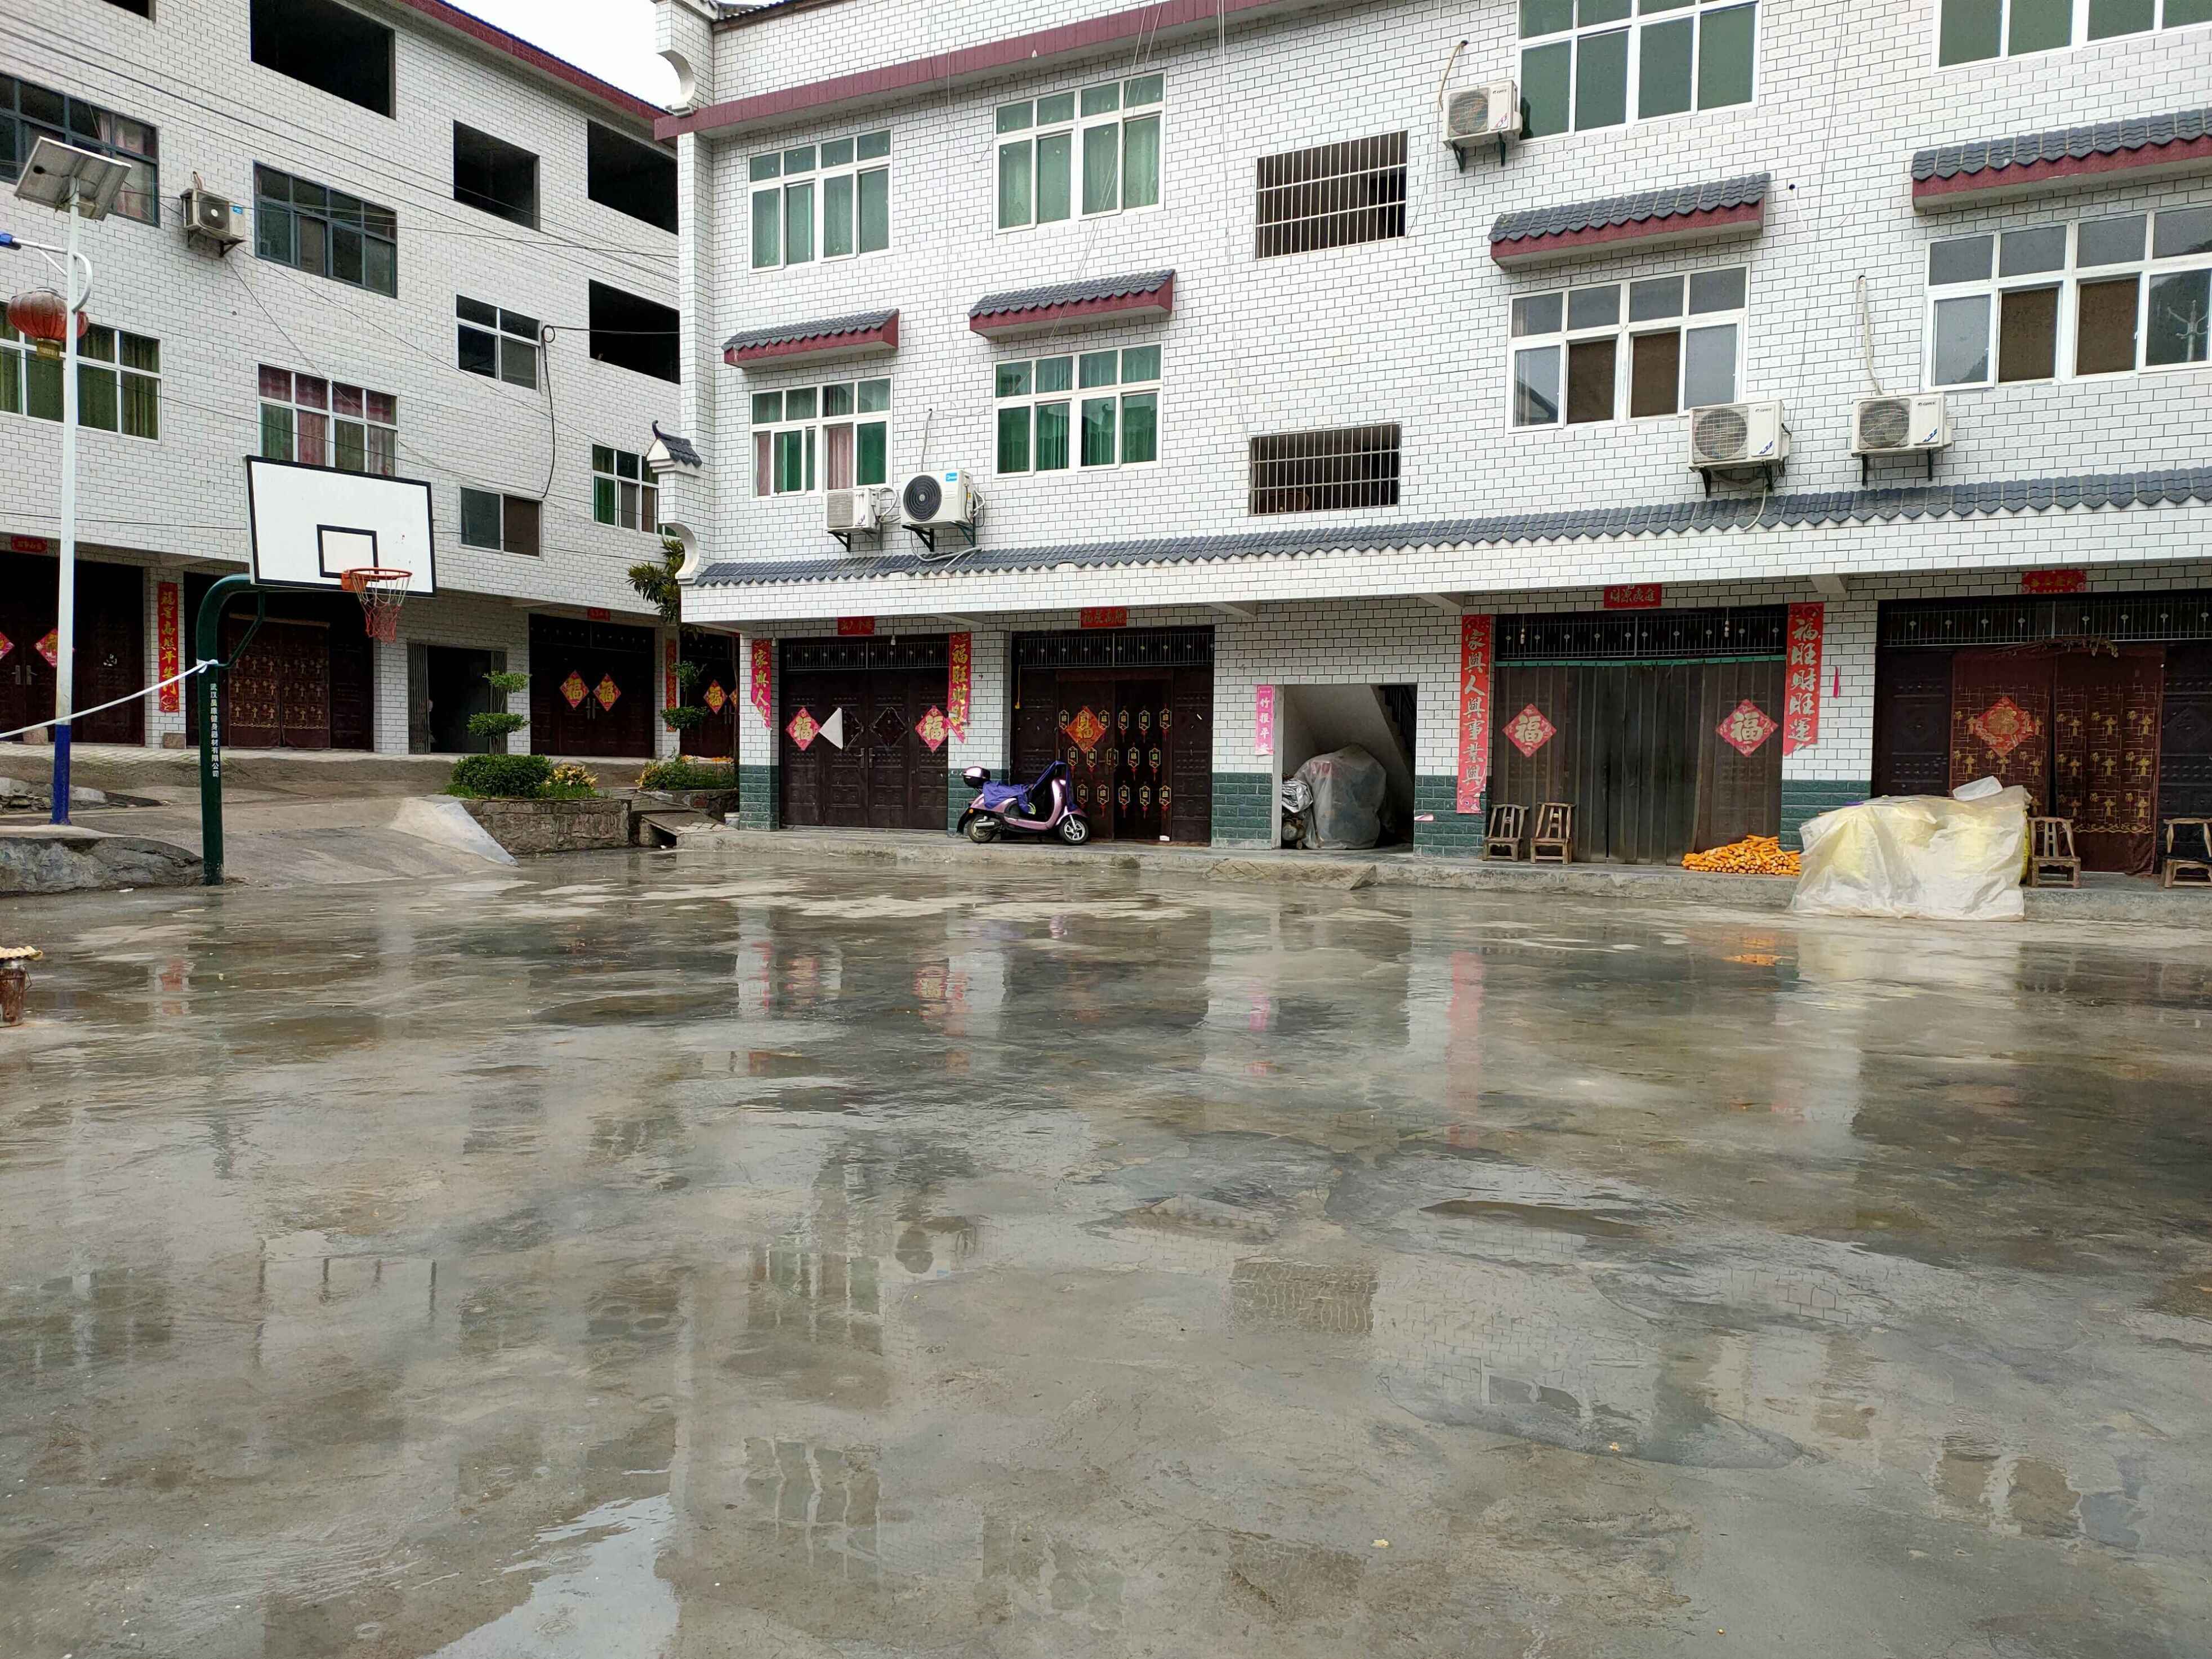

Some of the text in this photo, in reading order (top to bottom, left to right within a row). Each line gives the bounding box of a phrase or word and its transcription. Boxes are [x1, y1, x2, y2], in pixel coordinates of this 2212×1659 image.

[567, 677, 583, 701] 福
[599, 681, 616, 703] 福
[708, 686, 723, 706] 福
[794, 716, 813, 740] 福
[924, 715, 946, 741] 福
[1515, 714, 1542, 744] 福
[1730, 711, 1763, 742] 福
